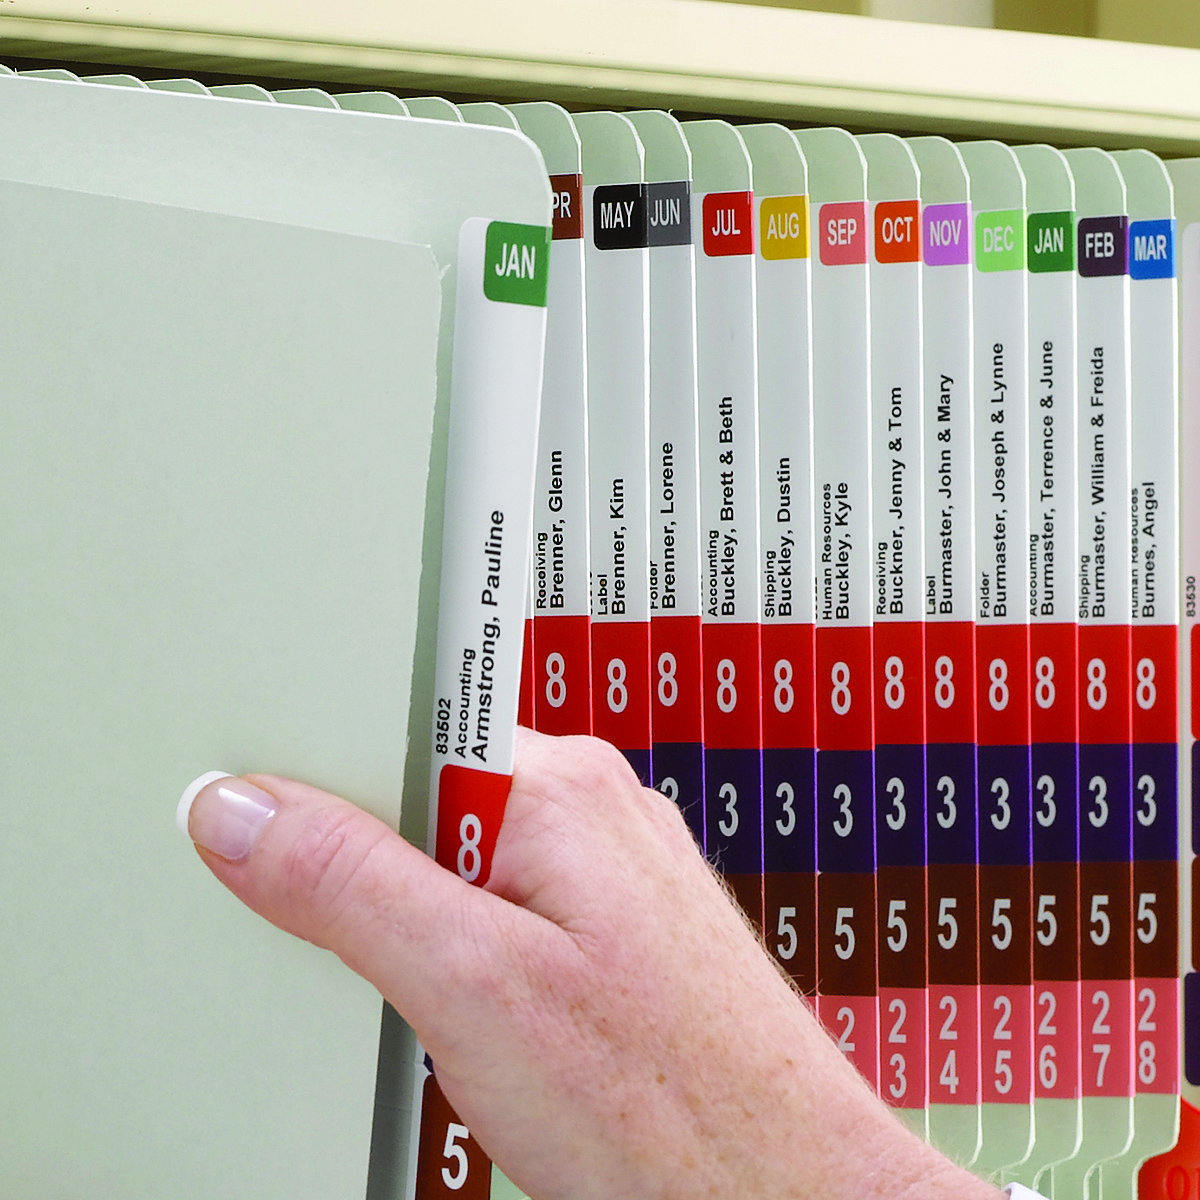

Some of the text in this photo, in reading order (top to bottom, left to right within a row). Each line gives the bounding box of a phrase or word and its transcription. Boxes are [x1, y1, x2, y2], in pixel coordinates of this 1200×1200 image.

[601, 201, 634, 228] MAY
[712, 209, 740, 236] JUL
[767, 213, 799, 239] AUG
[828, 219, 856, 245] SEP
[882, 217, 913, 243] OCT
[1034, 227, 1063, 253] JAN
[1086, 232, 1114, 258] FEB
[1135, 235, 1167, 261] MAR
[496, 243, 535, 279] JAN
[889, 388, 905, 614] Buckner, Jenny & Tom
[991, 343, 1007, 617] Burmaster, Joseph & Lynne
[1091, 347, 1106, 617] Burmaster, William & Freida
[549, 451, 565, 608] Brenner, Glenn
[610, 479, 626, 614] Brenner, Kim
[661, 443, 676, 608] Brenner, Lorene
[777, 458, 794, 616] Buckley, Dustin
[835, 483, 852, 619] Buckley, Kyle
[1142, 482, 1158, 617] Burnes, Angel
[536, 533, 548, 608] Receiving
[765, 551, 776, 617] Shipping
[468, 511, 503, 762] Armstrong, Pauline
[455, 649, 479, 758] Accounting
[935, 656, 954, 708] 8
[436, 698, 450, 754] 83502
[440, 1122, 469, 1190] 5
